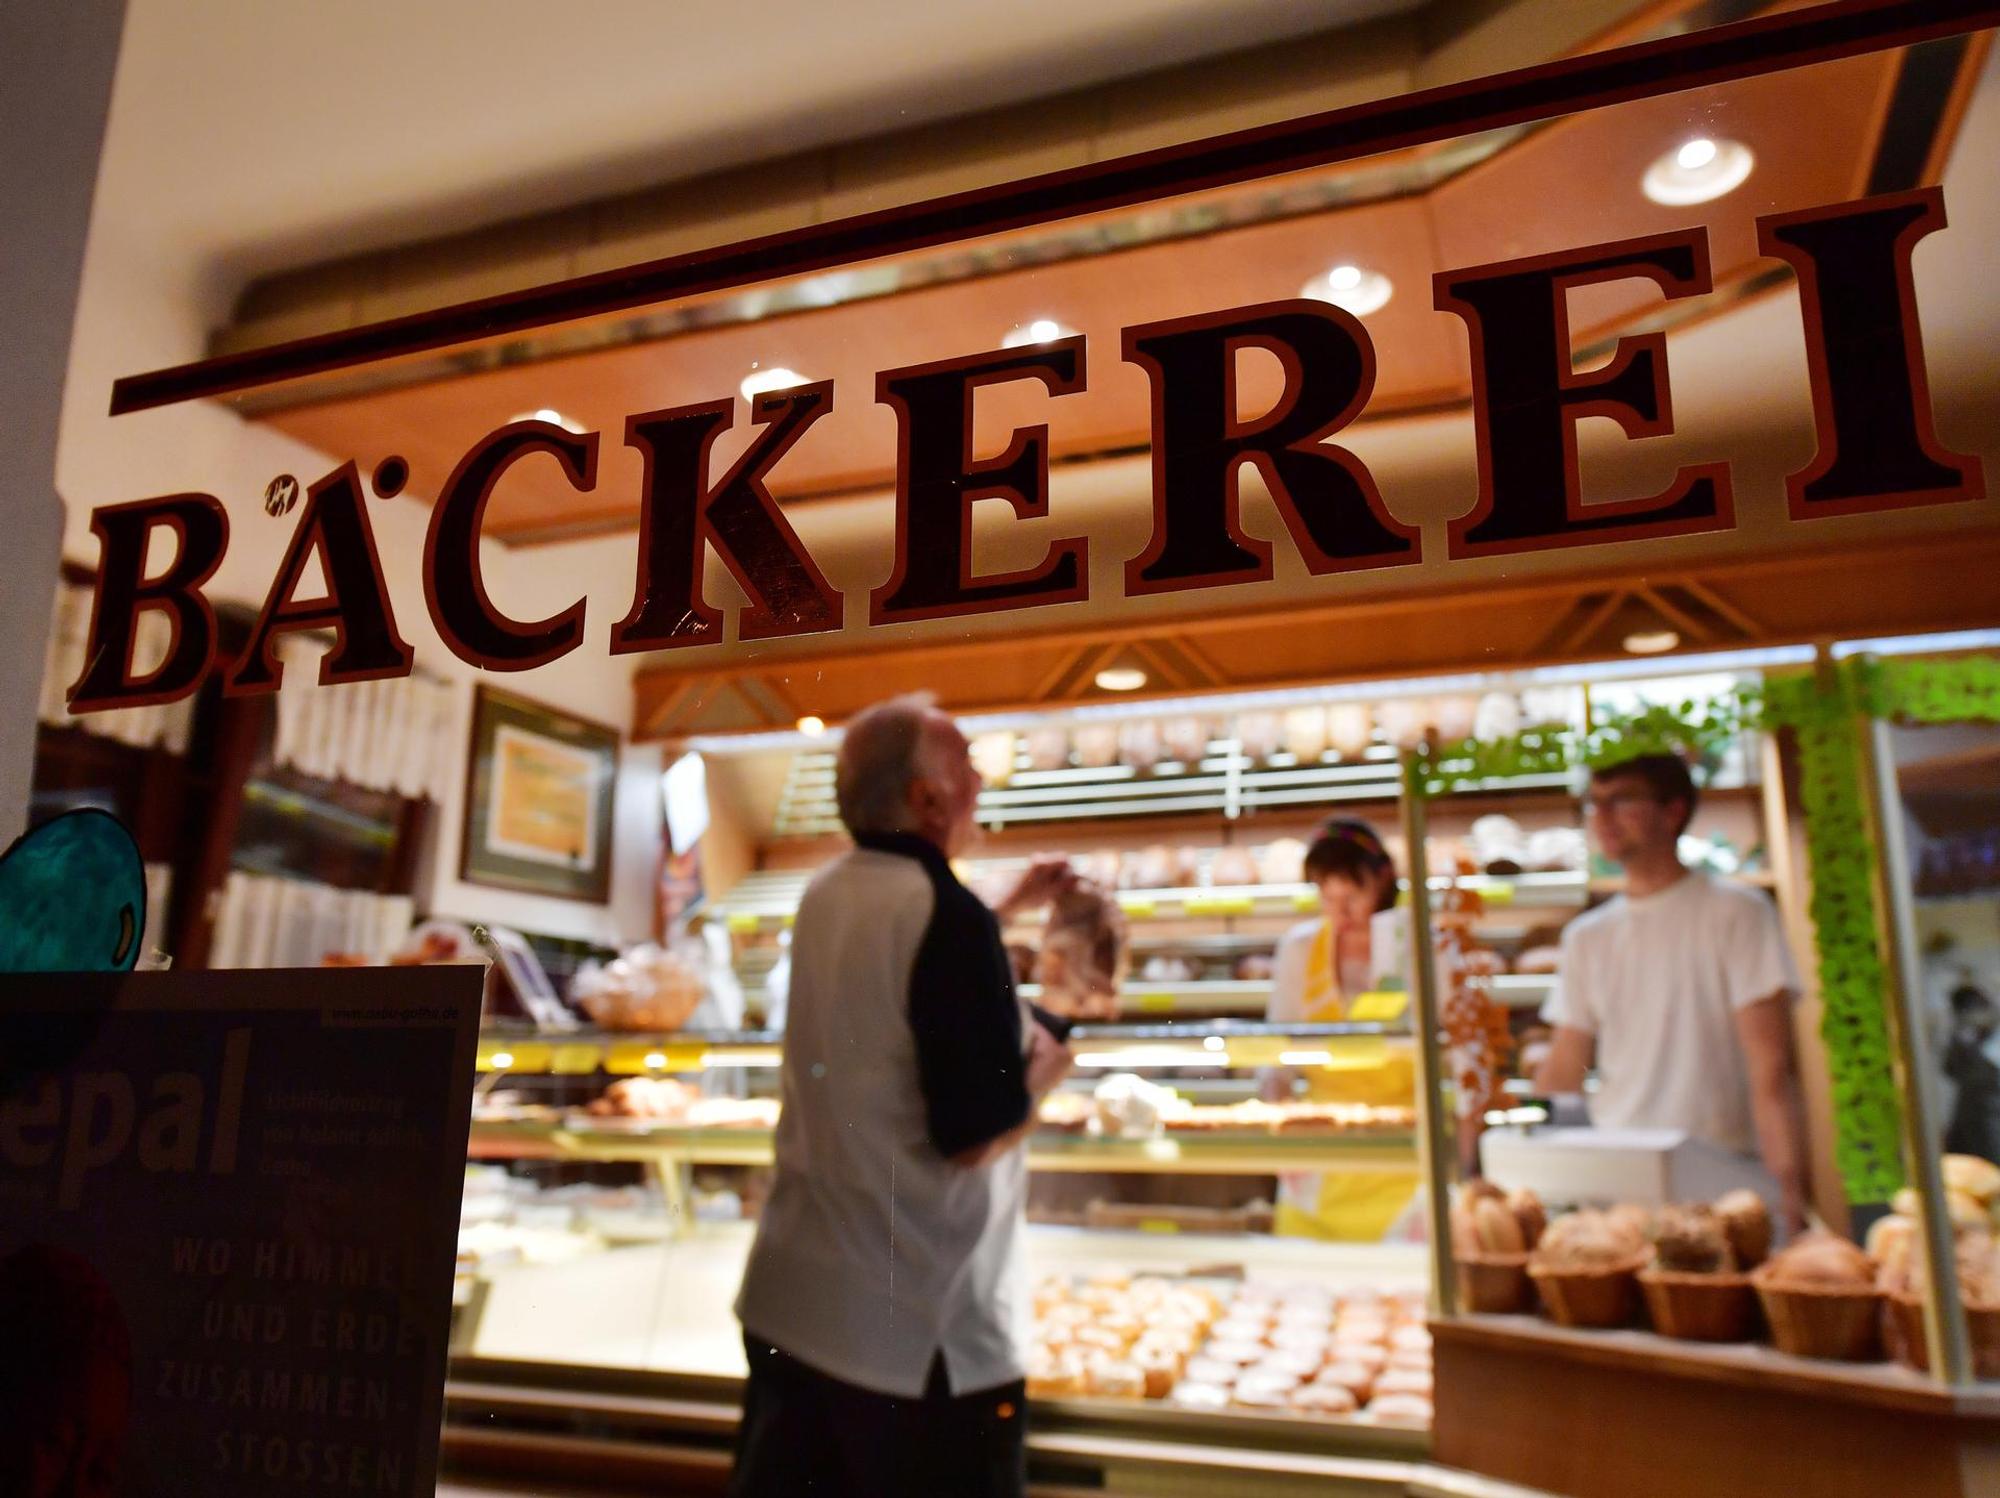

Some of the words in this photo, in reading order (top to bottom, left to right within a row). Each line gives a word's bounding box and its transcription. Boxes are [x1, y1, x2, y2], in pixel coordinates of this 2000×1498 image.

[68, 186, 1986, 713] BÄCKEREI
[172, 1236, 231, 1275] WO
[203, 1300, 286, 1344] UND
[311, 1307, 416, 1356] ERDE
[213, 1429, 403, 1492] STOSSEN
